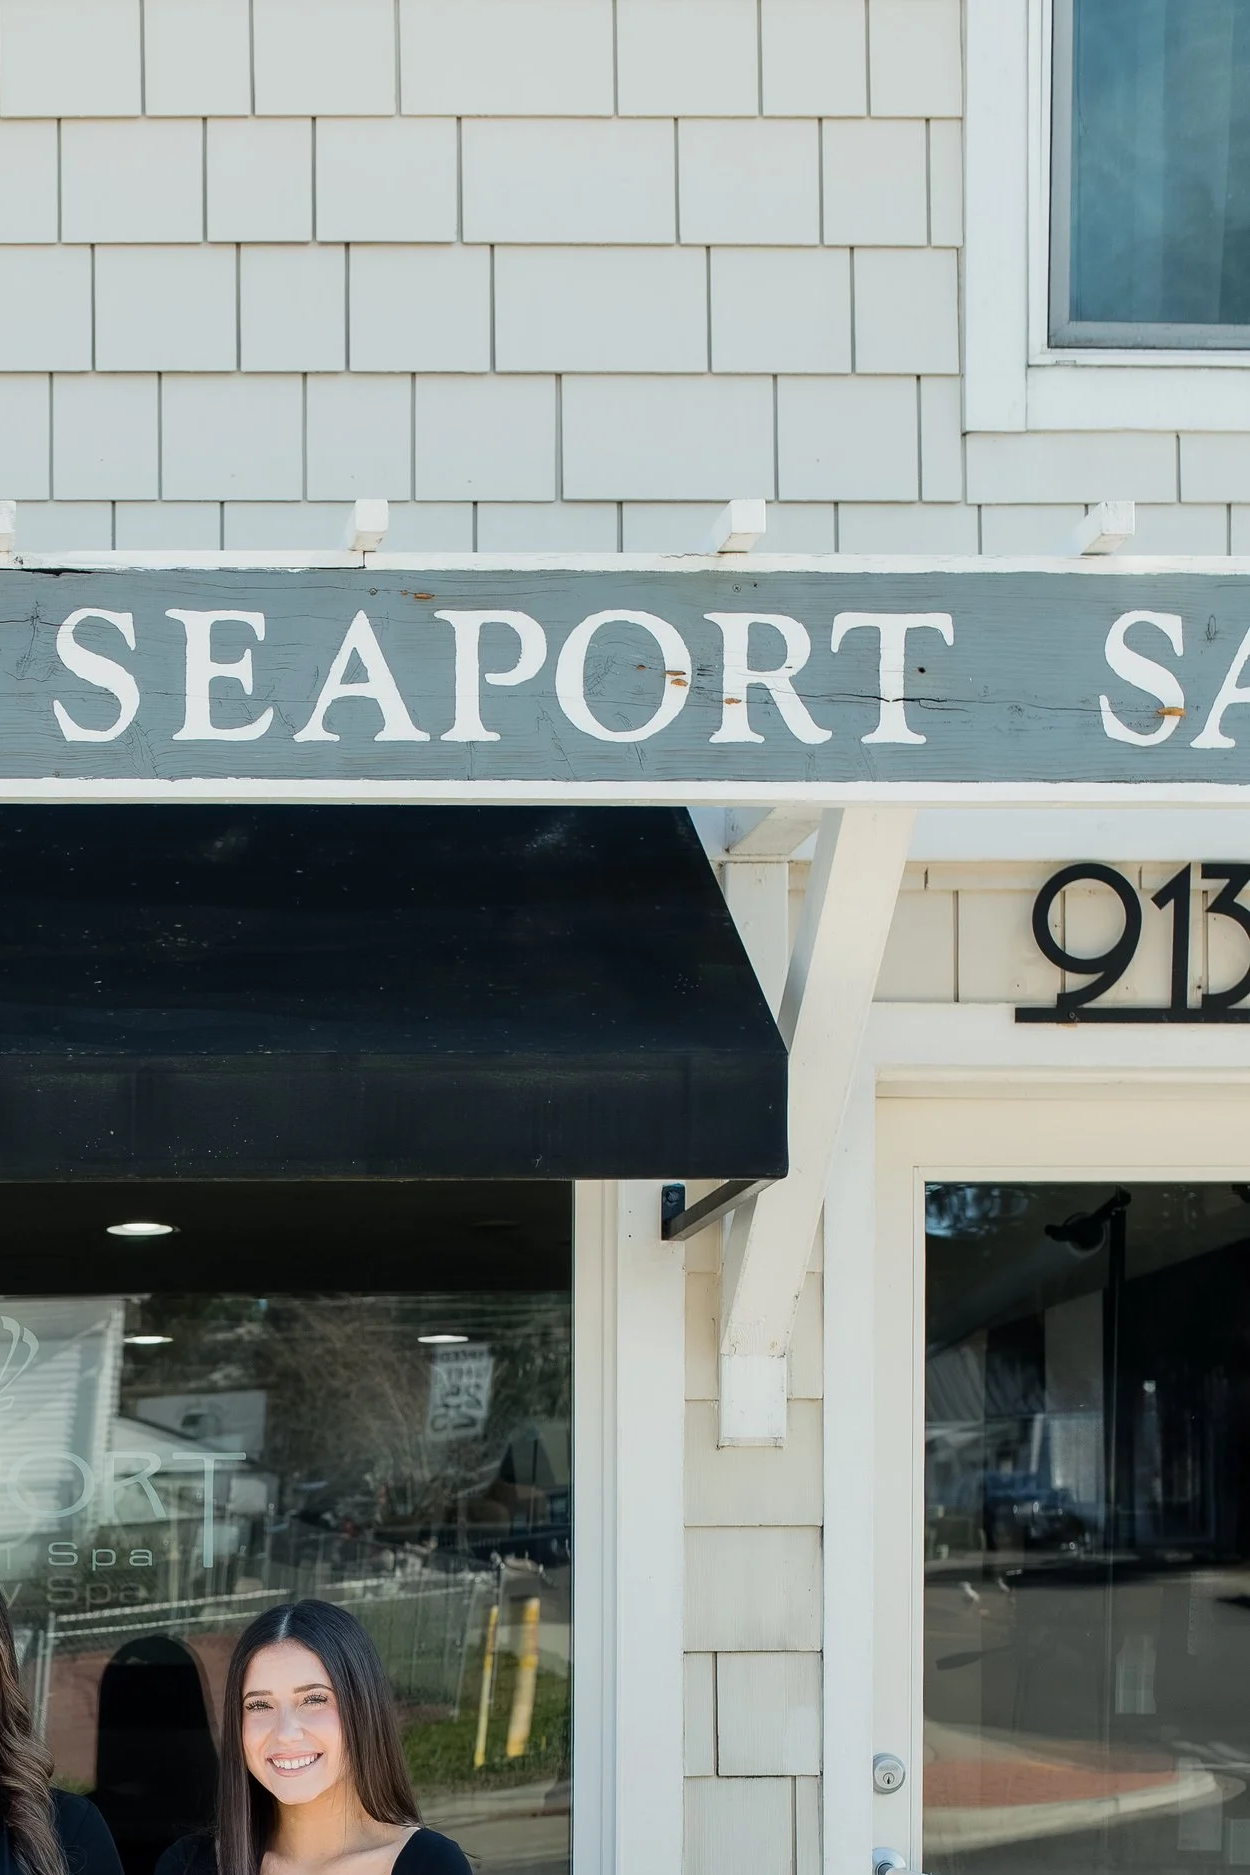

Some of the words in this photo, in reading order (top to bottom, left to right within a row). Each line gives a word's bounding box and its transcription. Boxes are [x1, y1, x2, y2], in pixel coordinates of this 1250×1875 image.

[54, 607, 955, 745] SEAPORT
[1032, 862, 1250, 1009] 913
[47, 1541, 155, 1571] Spa
